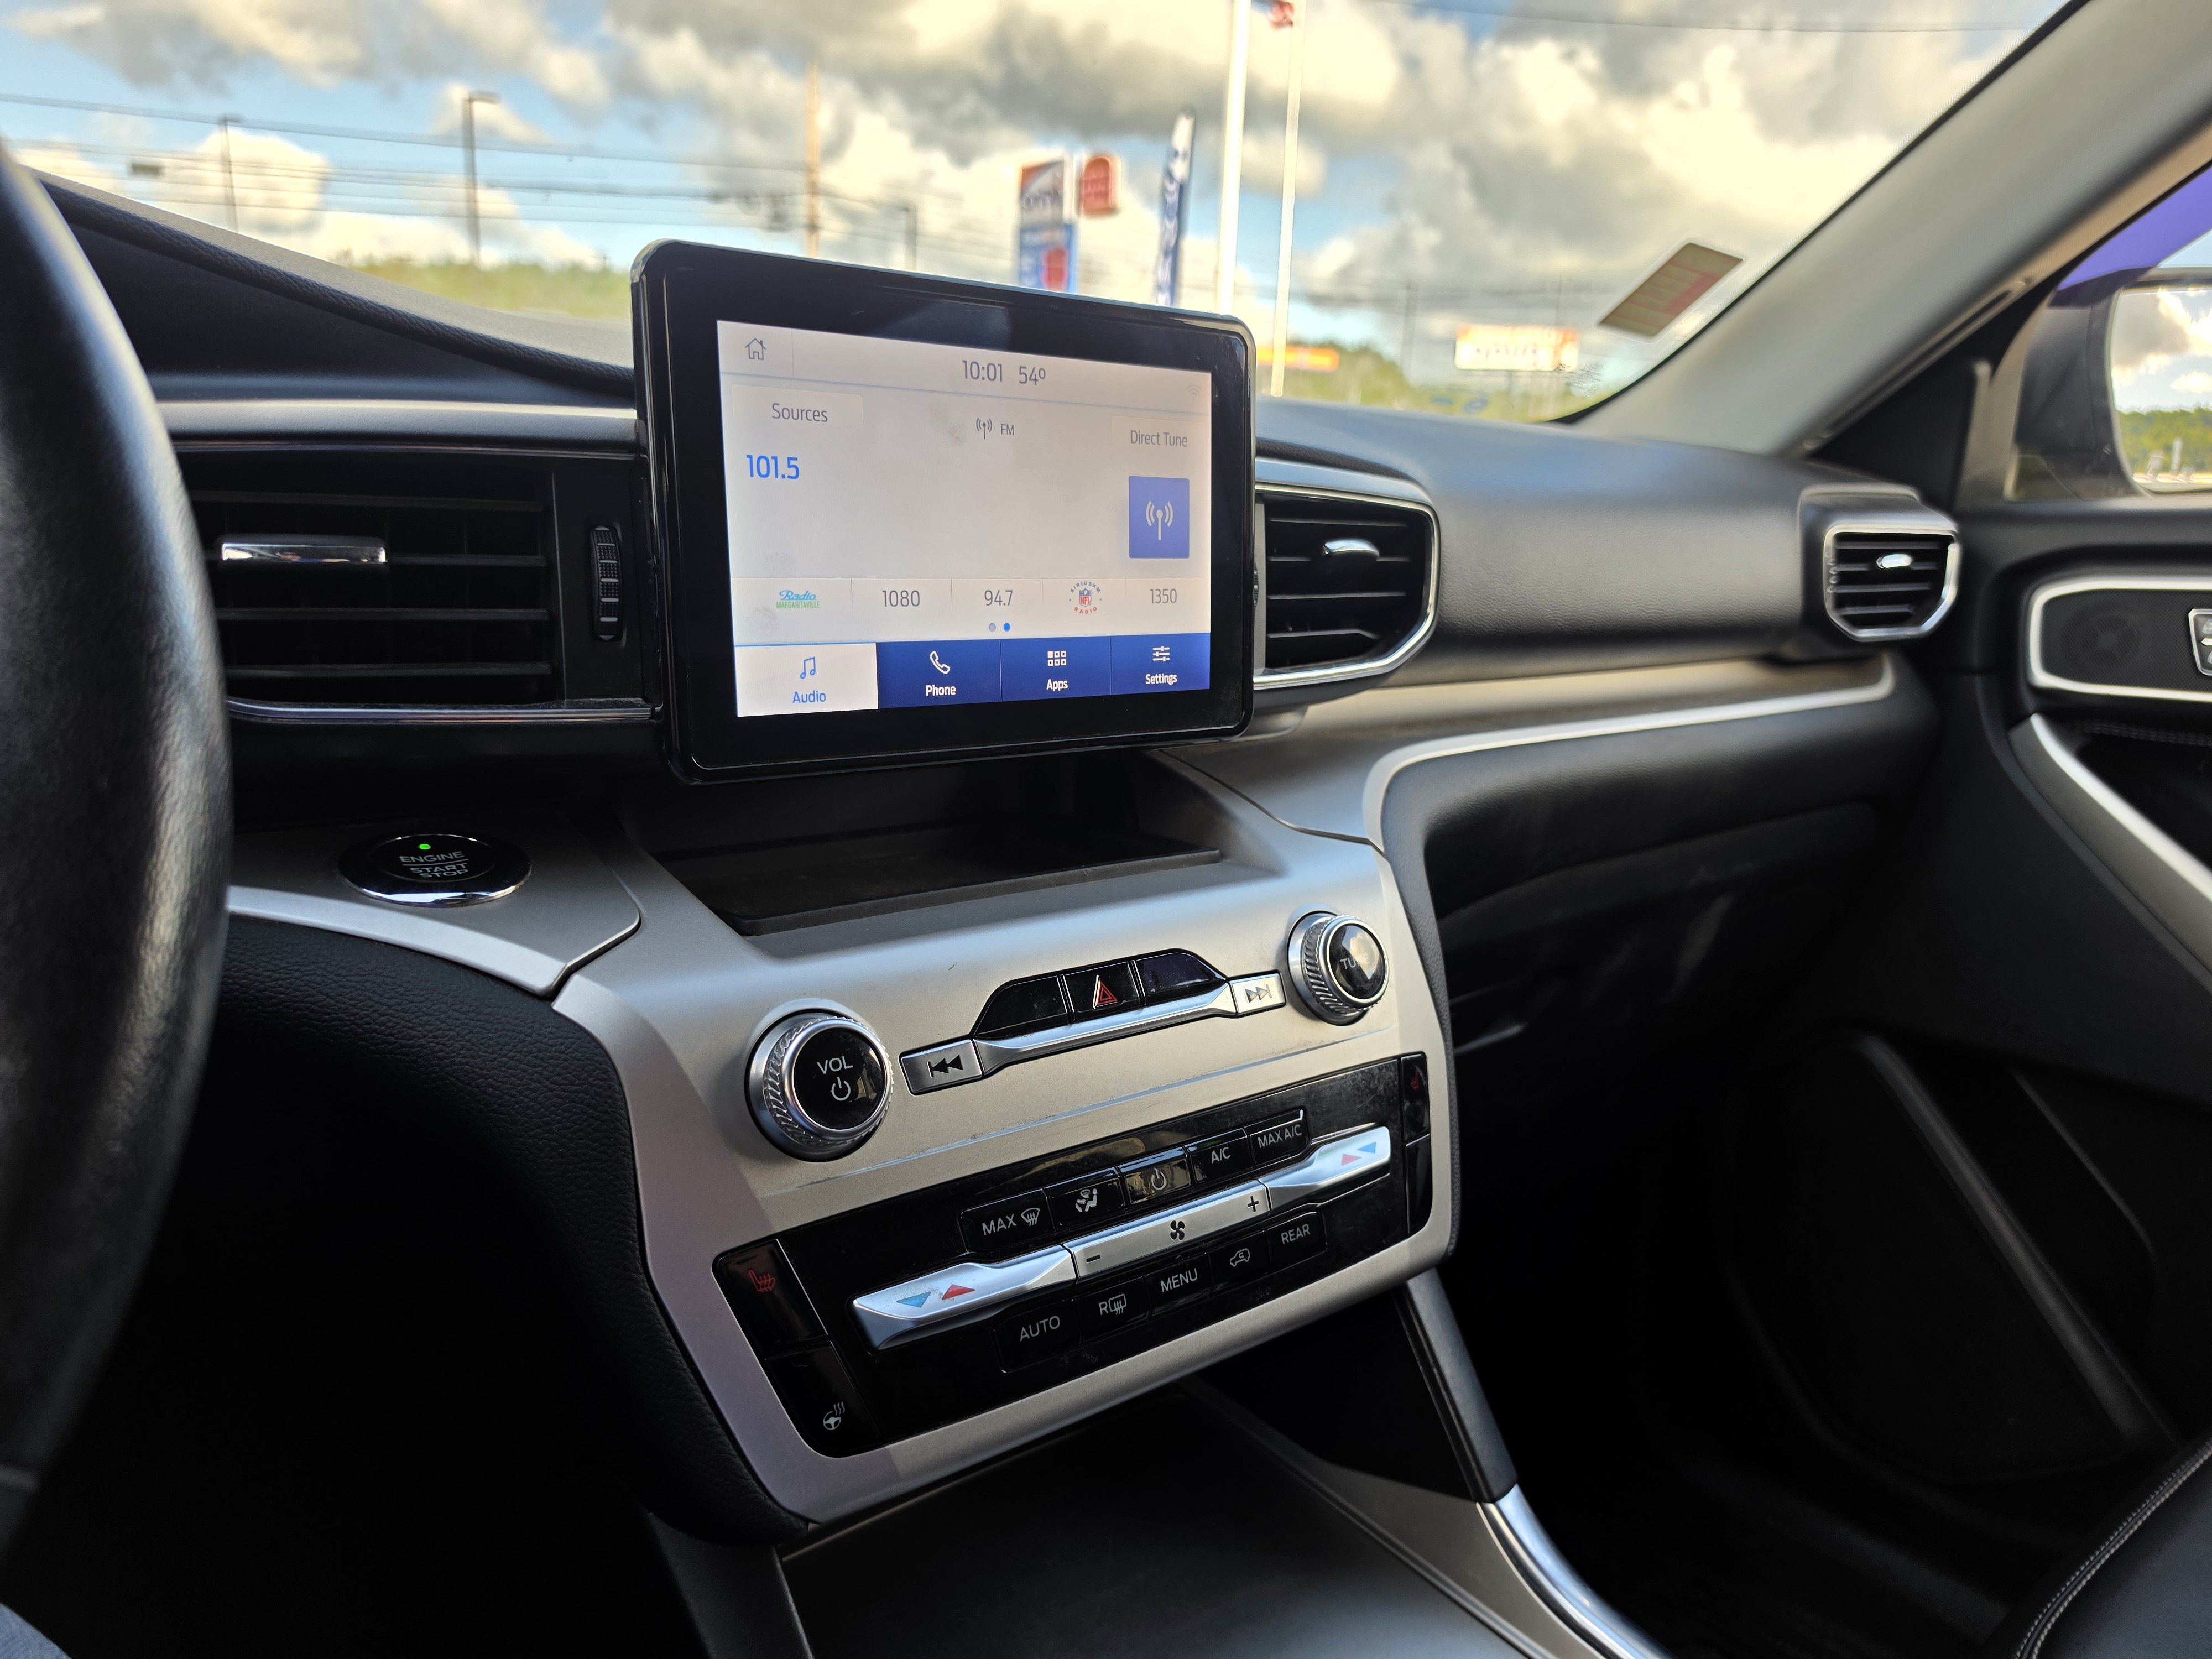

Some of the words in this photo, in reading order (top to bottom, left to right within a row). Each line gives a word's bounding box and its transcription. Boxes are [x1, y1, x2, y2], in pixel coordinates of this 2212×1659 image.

[962, 359, 1004, 383] 10:01
[771, 403, 828, 422] Sources
[1000, 424, 1015, 436] FM
[1130, 430, 1161, 446] Direct
[1163, 432, 1188, 447] Tune
[746, 454, 800, 480] 101.5
[779, 589, 817, 601] Radio
[882, 589, 921, 608] 1080
[984, 589, 1013, 607] 94.7
[1081, 596, 1091, 605] NFL
[1150, 588, 1177, 604] 1350
[1074, 606, 1097, 614] RADIO
[1046, 679, 1068, 691] Apps
[1145, 673, 1177, 685] Settings
[792, 690, 827, 704] Audio
[925, 684, 956, 697] Phone
[399, 851, 465, 863] ENGINE
[410, 863, 468, 874] START
[420, 869, 468, 878] STOP
[816, 1056, 854, 1075] VOL
[1258, 1132, 1284, 1149] MAX
[1284, 1124, 1302, 1140] A/C
[1211, 1146, 1232, 1164] A/C
[982, 1213, 1017, 1236] MAX
[1281, 1223, 1310, 1245] REAR
[1160, 1267, 1198, 1293] MENU
[1019, 1315, 1061, 1342] AUTO
